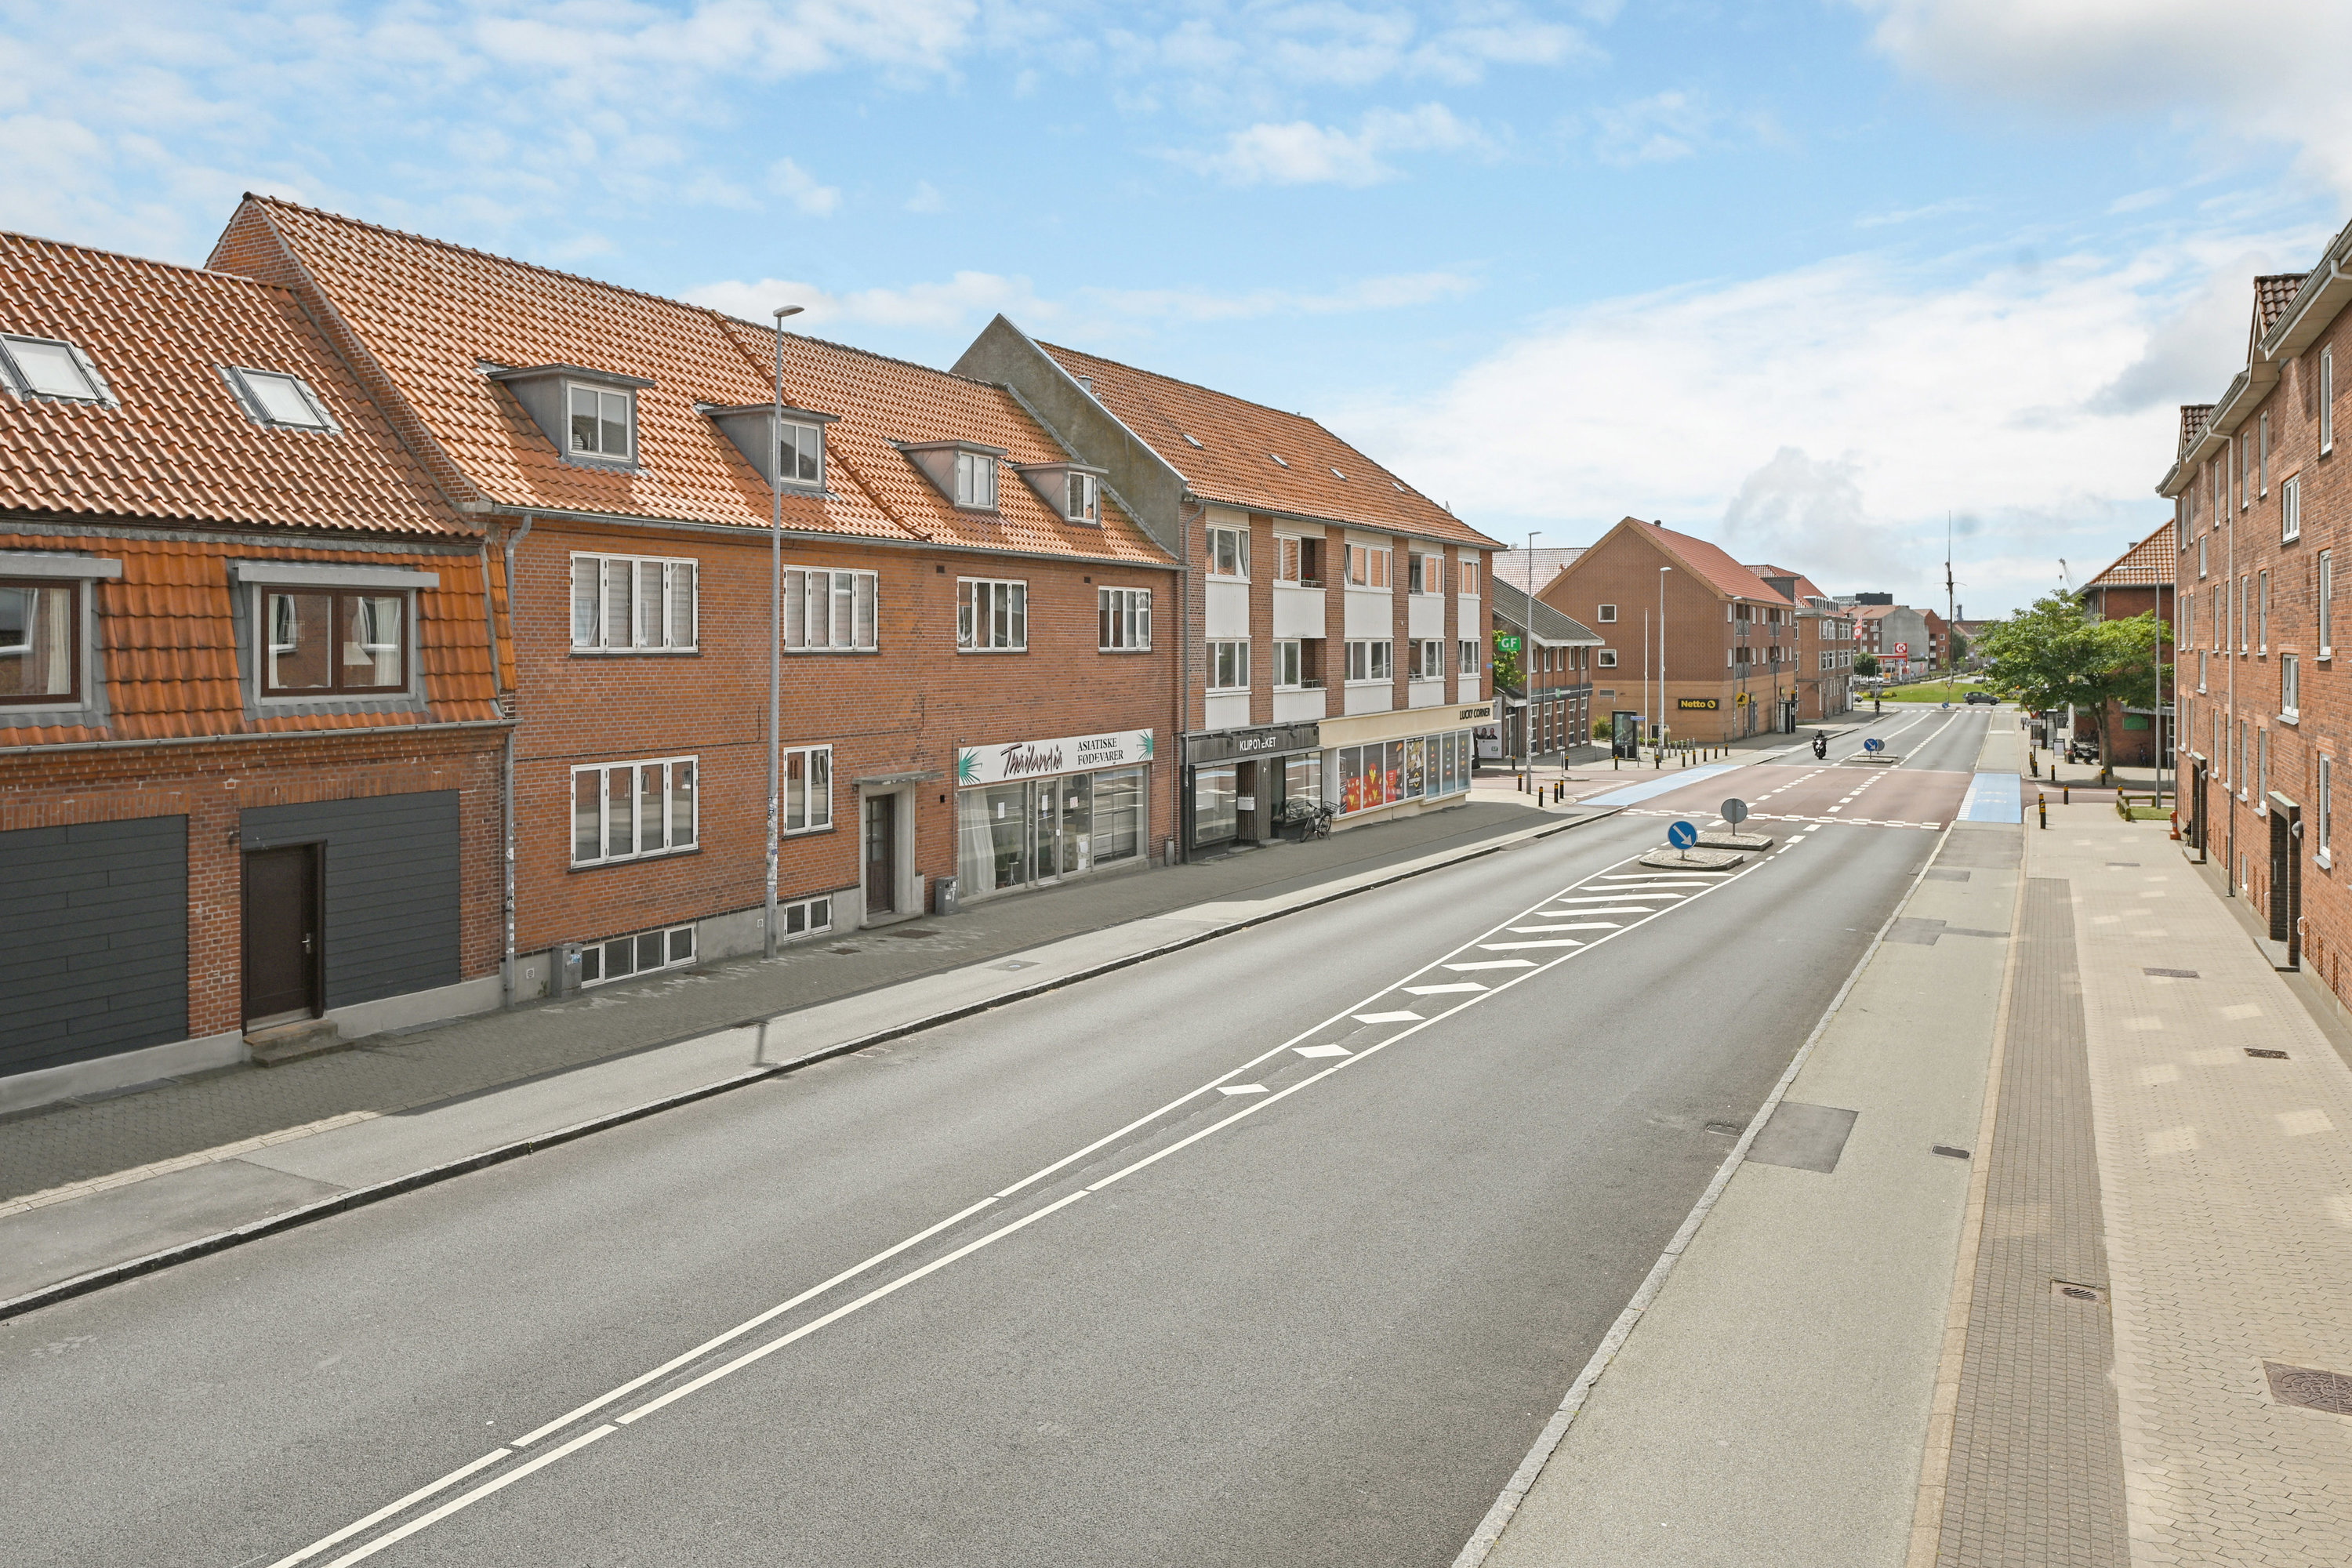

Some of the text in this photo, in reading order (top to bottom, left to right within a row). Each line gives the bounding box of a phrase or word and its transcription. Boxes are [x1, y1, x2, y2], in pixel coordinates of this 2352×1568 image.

[1501, 638, 1517, 648] GF
[1460, 708, 1490, 720] LUCKY CORNER
[1077, 738, 1117, 752] ASIATISKE
[1000, 743, 1063, 778] Thailandia
[1078, 750, 1123, 765] FØDEVARER
